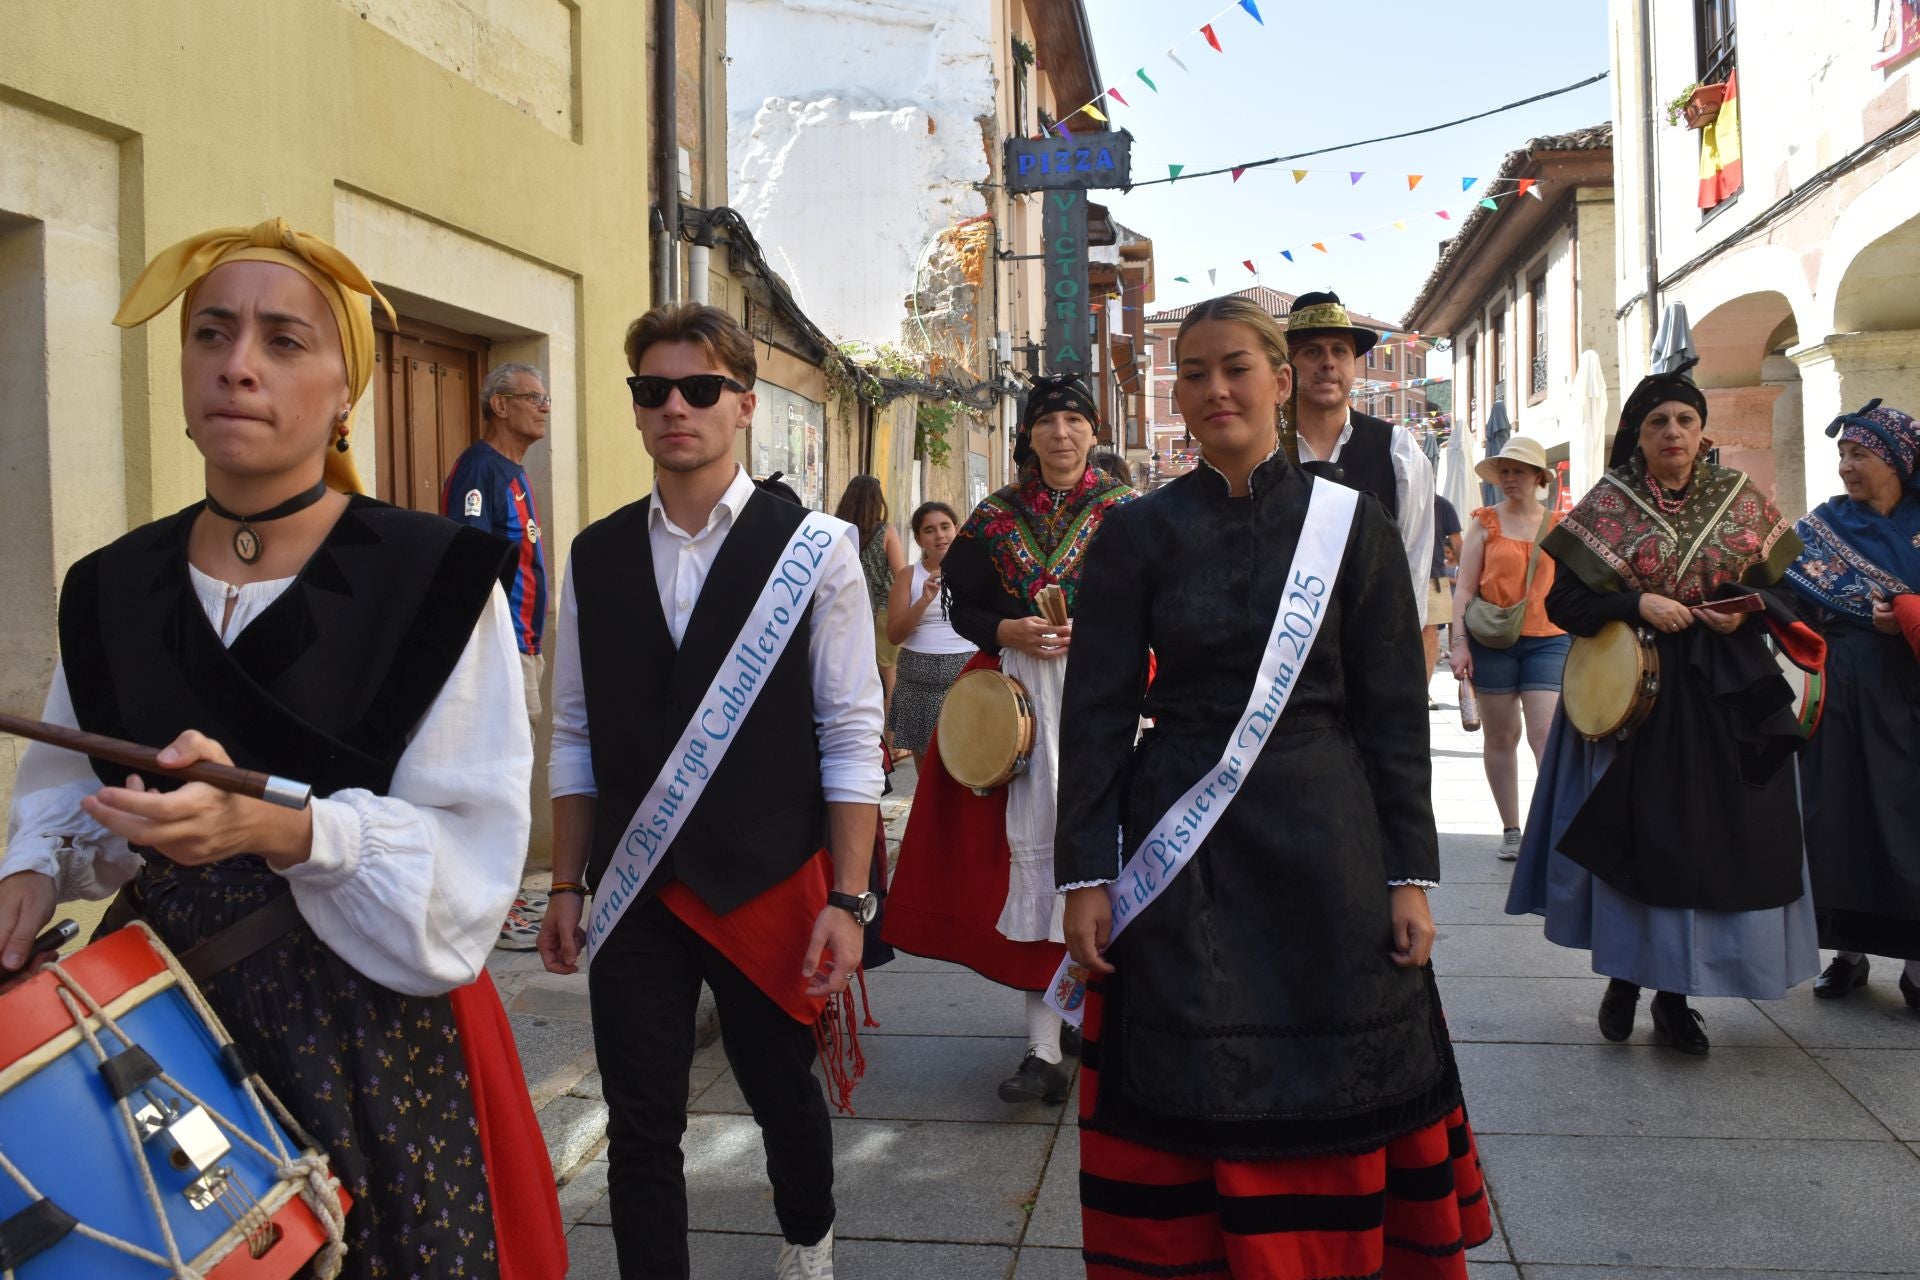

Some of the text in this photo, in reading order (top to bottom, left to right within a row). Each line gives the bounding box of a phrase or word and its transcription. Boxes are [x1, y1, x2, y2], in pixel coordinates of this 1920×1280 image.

[1018, 148, 1115, 176] PIZZA
[1054, 193, 1079, 362] VICTORIA
[1278, 570, 1326, 661] 2025
[625, 738, 709, 866] Pisuerga
[701, 606, 790, 741] Caballero
[772, 524, 832, 607] 2025
[1237, 662, 1294, 748] Dama
[1142, 755, 1241, 879] Pisuerga
[1133, 870, 1157, 905] de
